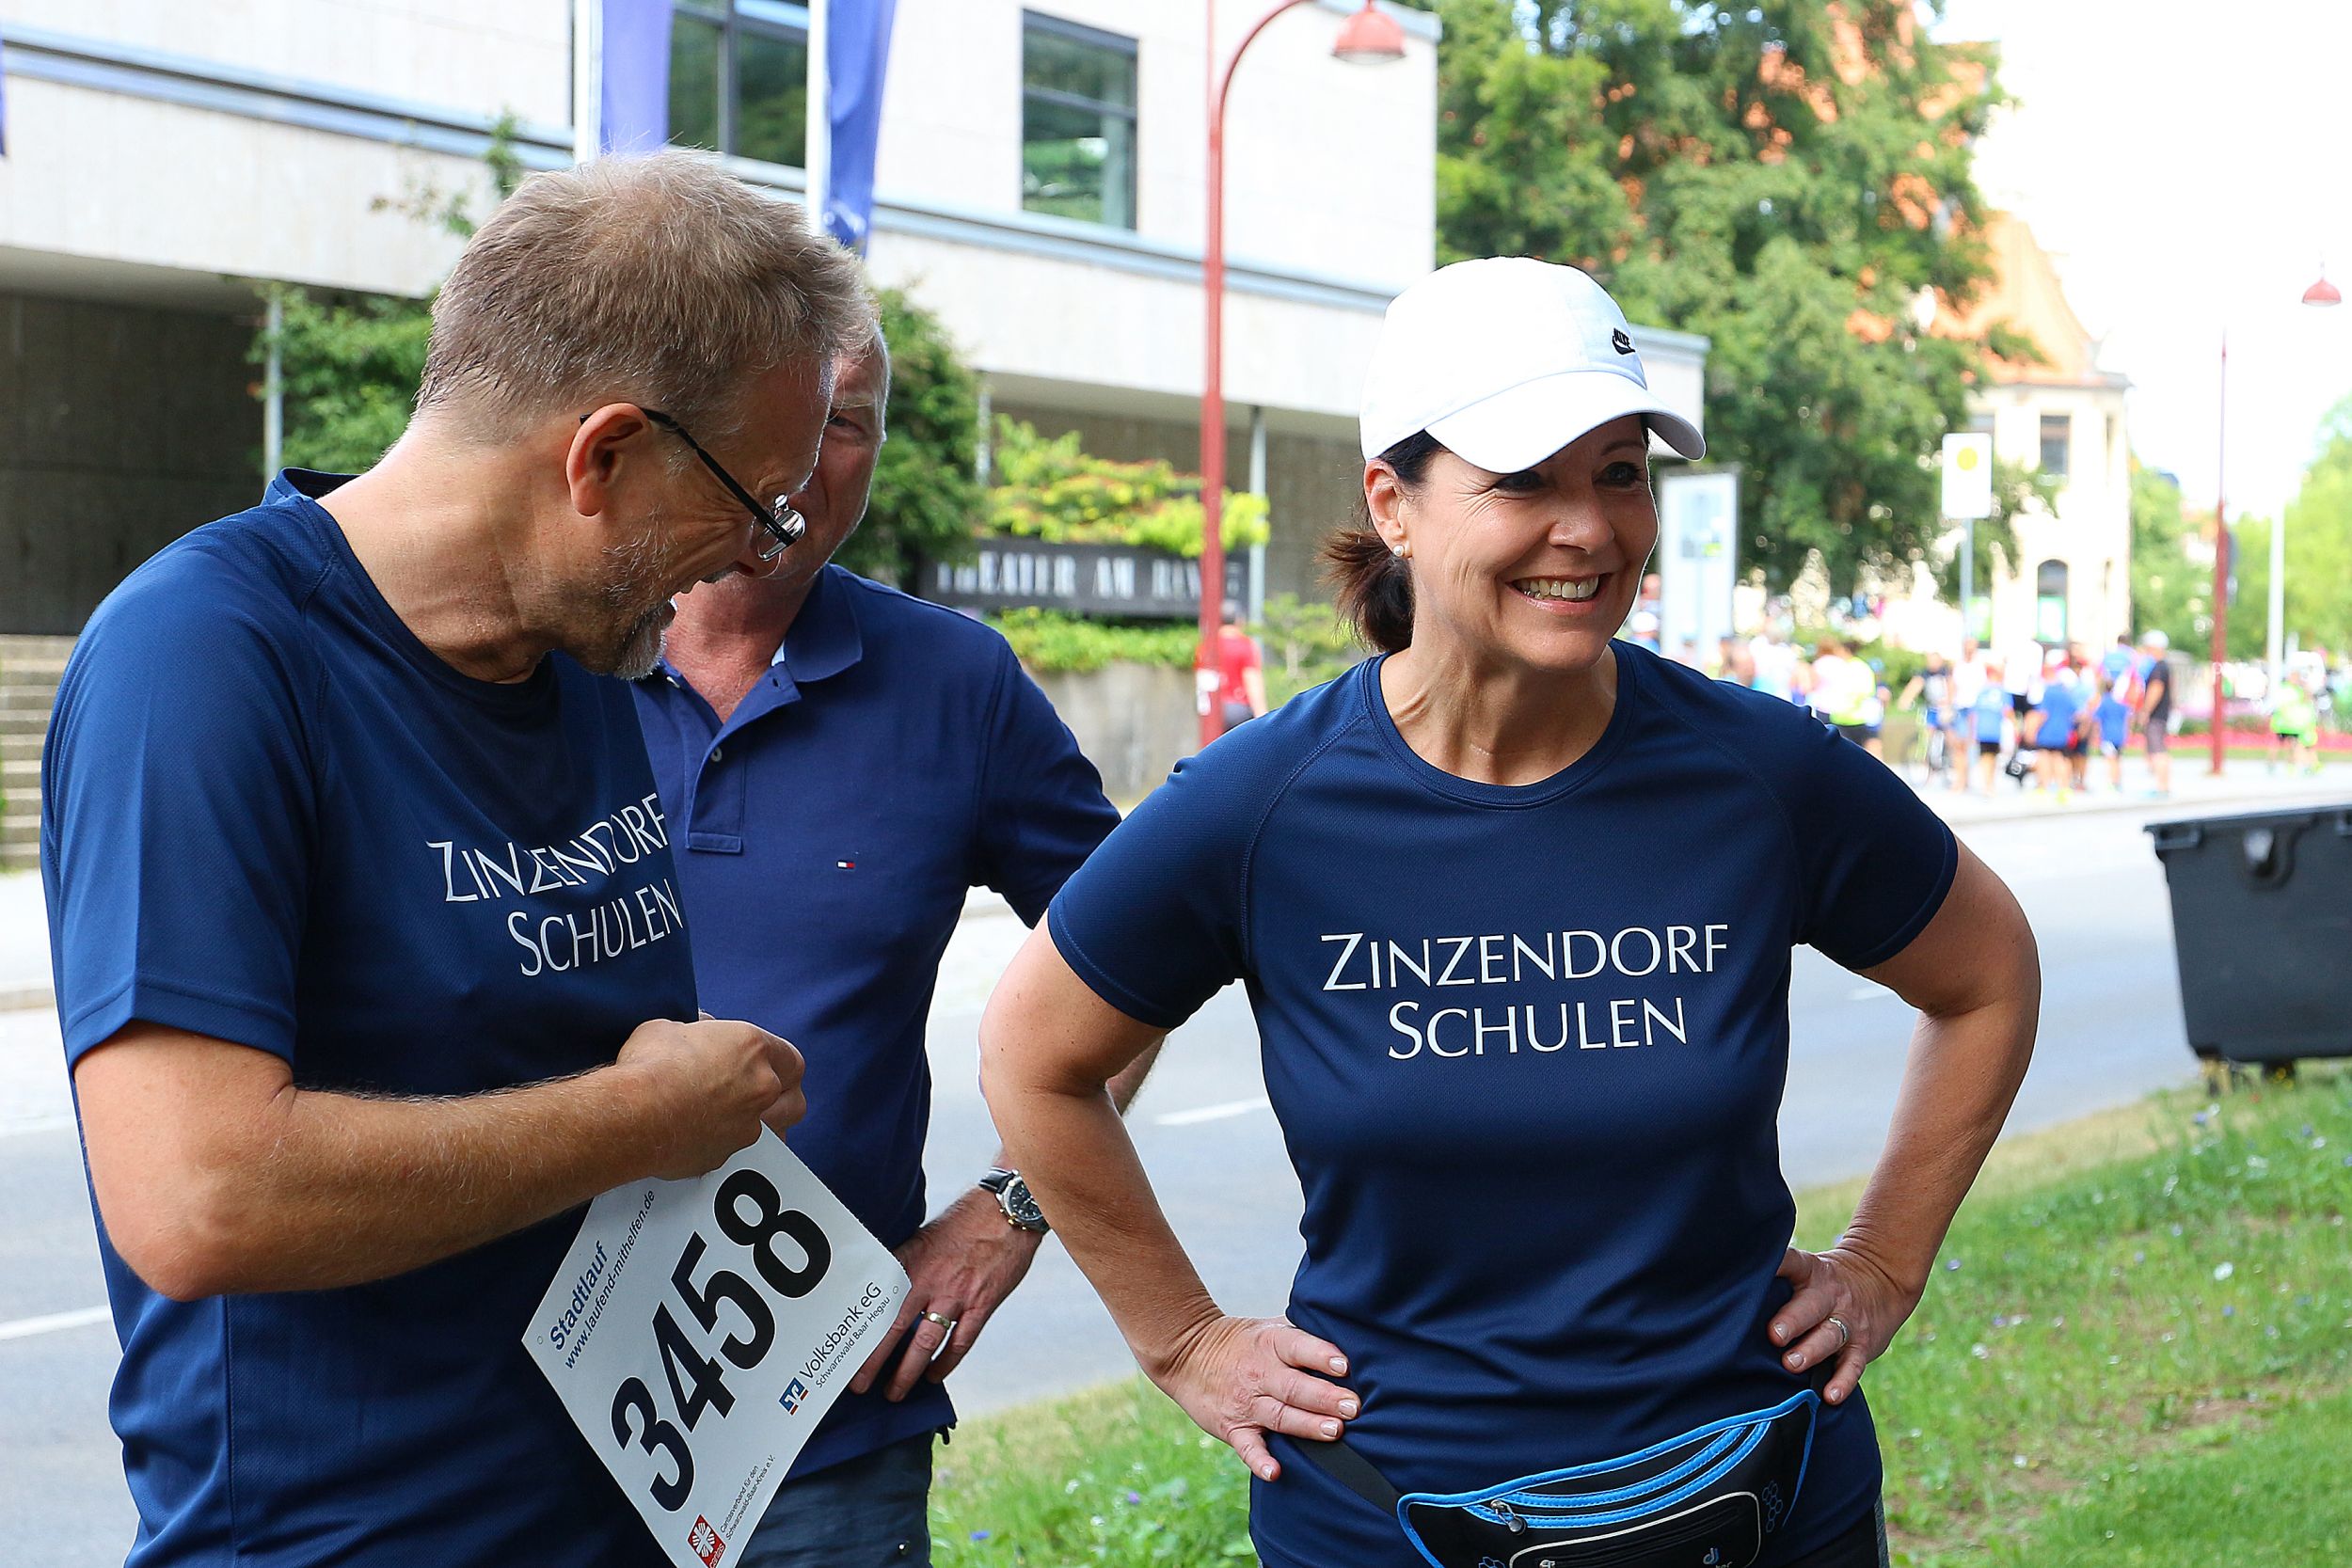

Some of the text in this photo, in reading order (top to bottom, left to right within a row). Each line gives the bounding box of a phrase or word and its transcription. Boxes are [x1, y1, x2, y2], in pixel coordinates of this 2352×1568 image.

[424, 792, 669, 902] ZINZENDORF
[507, 879, 684, 976] SCHULEN
[1321, 924, 1728, 991] ZINZENDORF
[1389, 997, 1687, 1060] SCHULEN
[549, 1241, 608, 1351] Stadtlauf
[565, 1190, 656, 1370] www.laufend-mithelfen.de
[611, 1168, 832, 1512] 3458
[800, 1282, 882, 1379] Volksbank eG
[816, 1296, 890, 1388] Schwarzwald Baar Hegau
